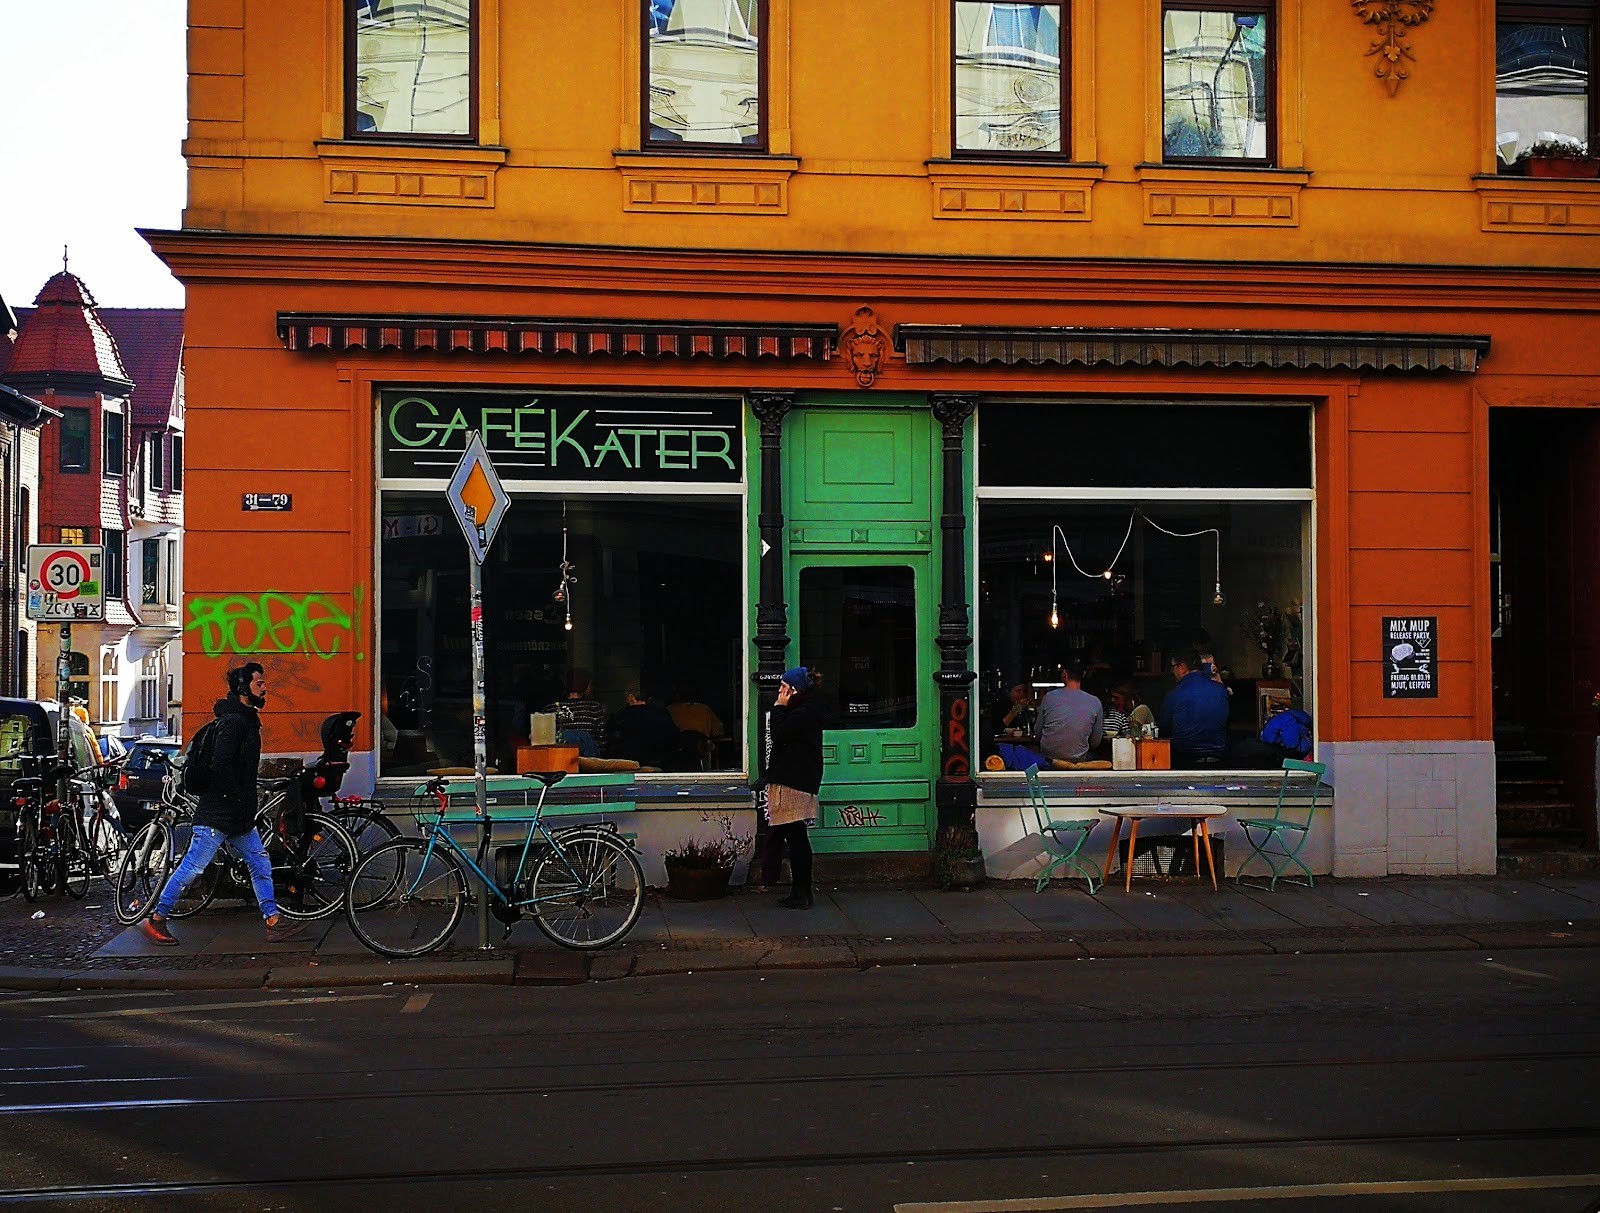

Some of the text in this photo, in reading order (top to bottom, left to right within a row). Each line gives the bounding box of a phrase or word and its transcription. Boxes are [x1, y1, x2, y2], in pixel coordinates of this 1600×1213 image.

[388, 397, 736, 470] CAFÉ KATER
[50, 563, 80, 586] 30
[1390, 620, 1430, 632] MIX MUP
[1408, 682, 1430, 690] LEIPZIG
